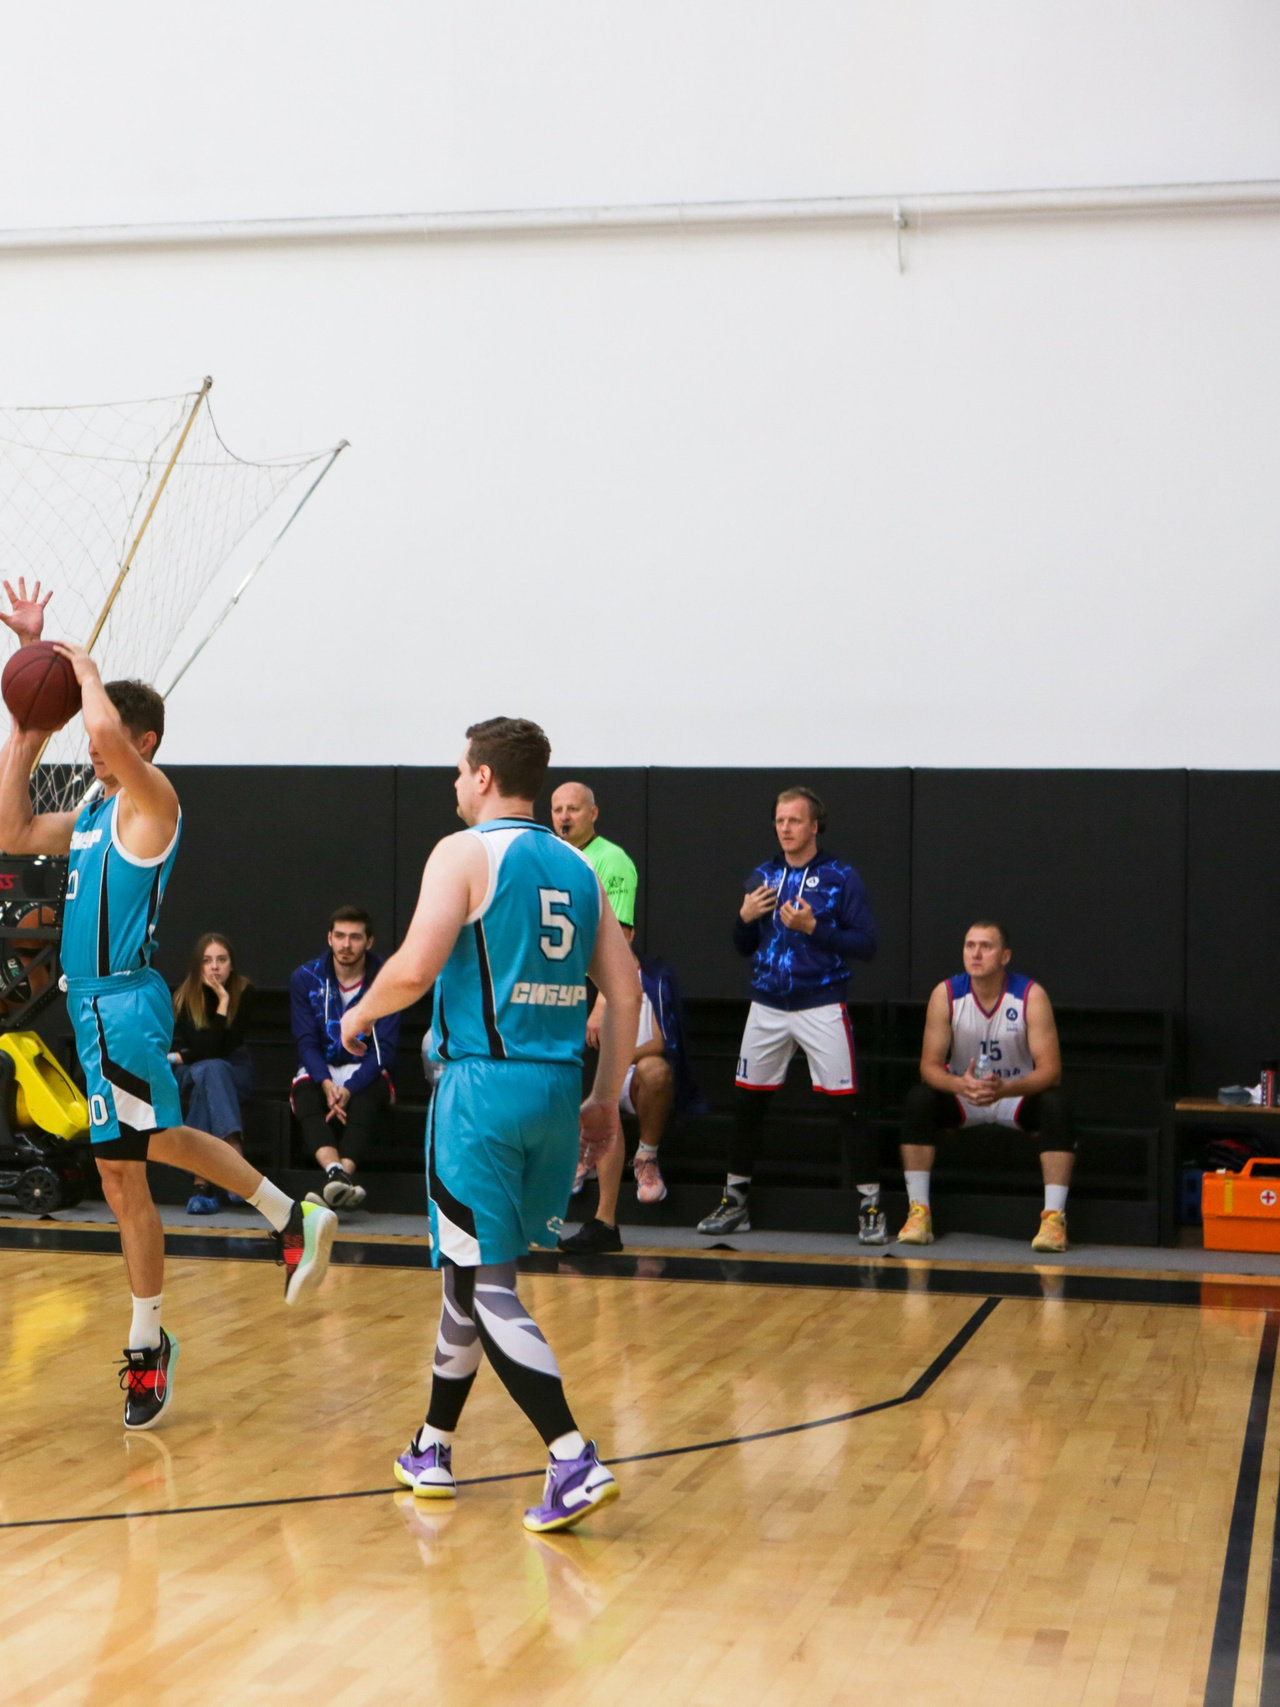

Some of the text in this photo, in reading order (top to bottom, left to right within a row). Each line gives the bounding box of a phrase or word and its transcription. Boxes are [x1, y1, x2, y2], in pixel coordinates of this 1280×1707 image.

[538, 886, 577, 962] 5
[980, 1040, 1002, 1061] 15
[88, 1093, 109, 1127] 0
